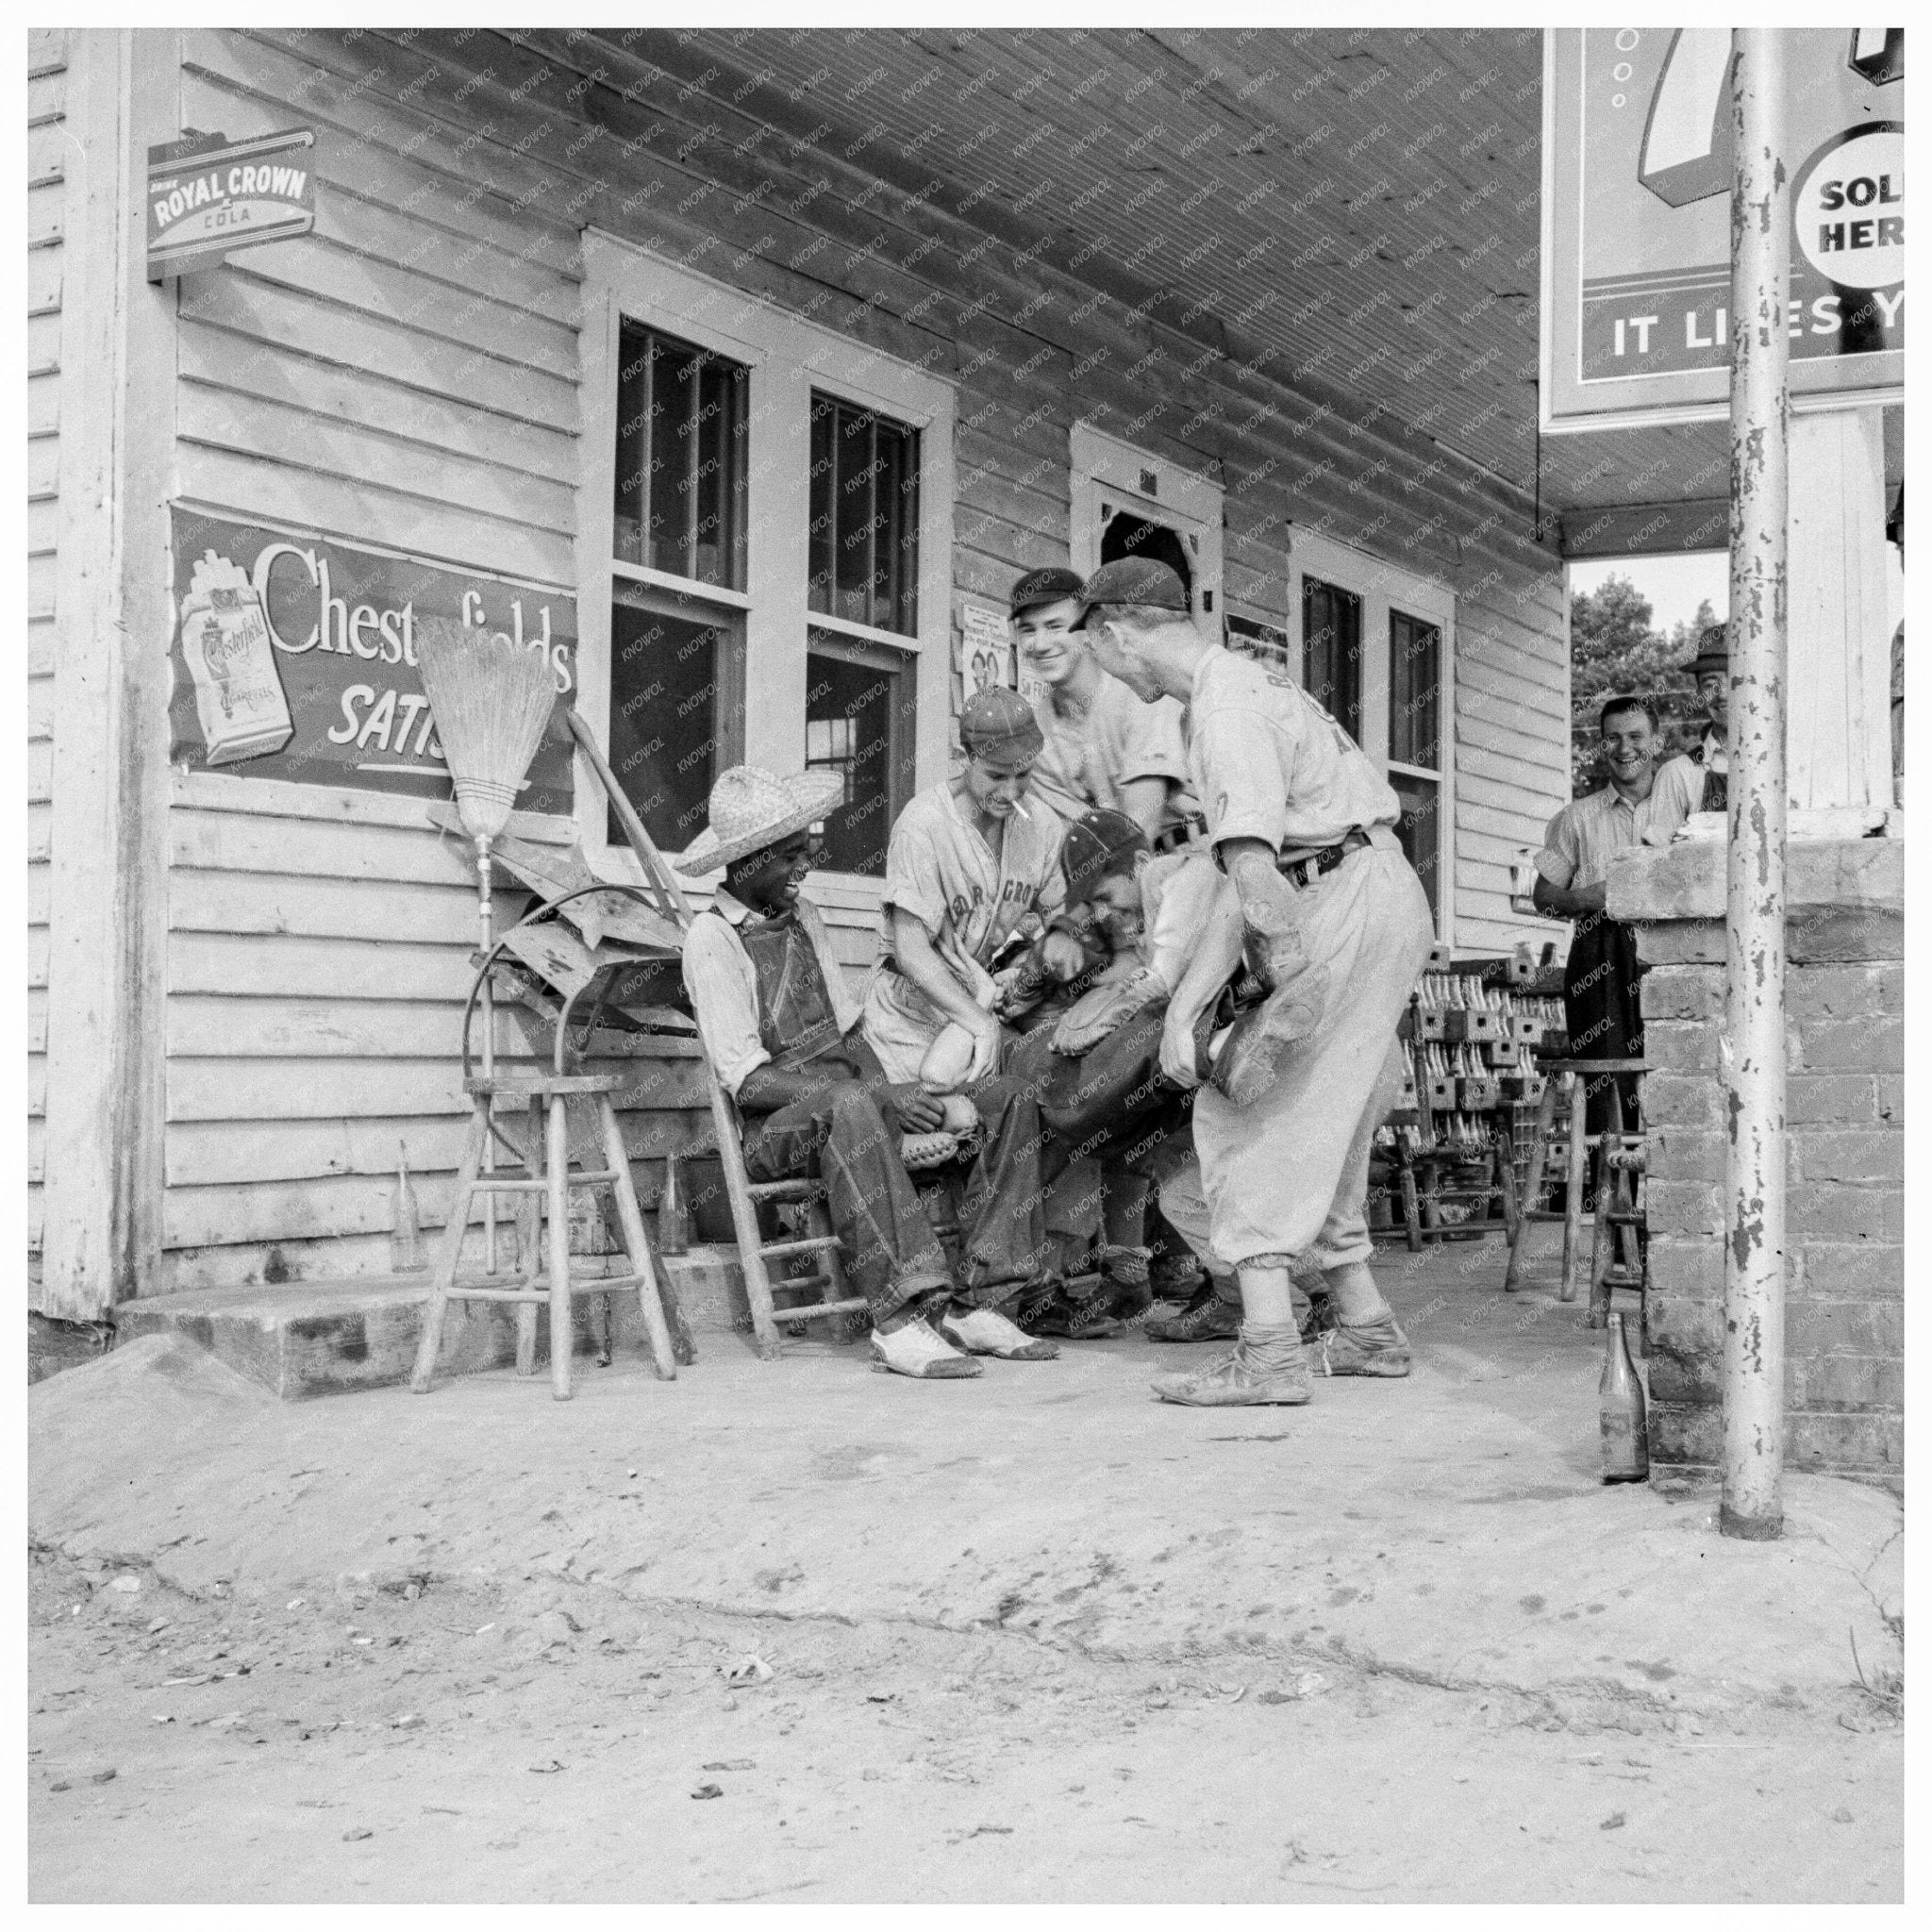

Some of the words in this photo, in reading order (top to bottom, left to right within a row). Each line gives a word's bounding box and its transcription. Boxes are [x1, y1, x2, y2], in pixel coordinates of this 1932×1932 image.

[154, 173, 225, 228] ROYAL
[227, 165, 307, 200] CROWN
[204, 208, 252, 228] COLA
[1819, 174, 1905, 211] SOL
[1614, 314, 1659, 357] IT
[1686, 295, 1842, 349] LIES
[252, 542, 573, 694] Chestflds
